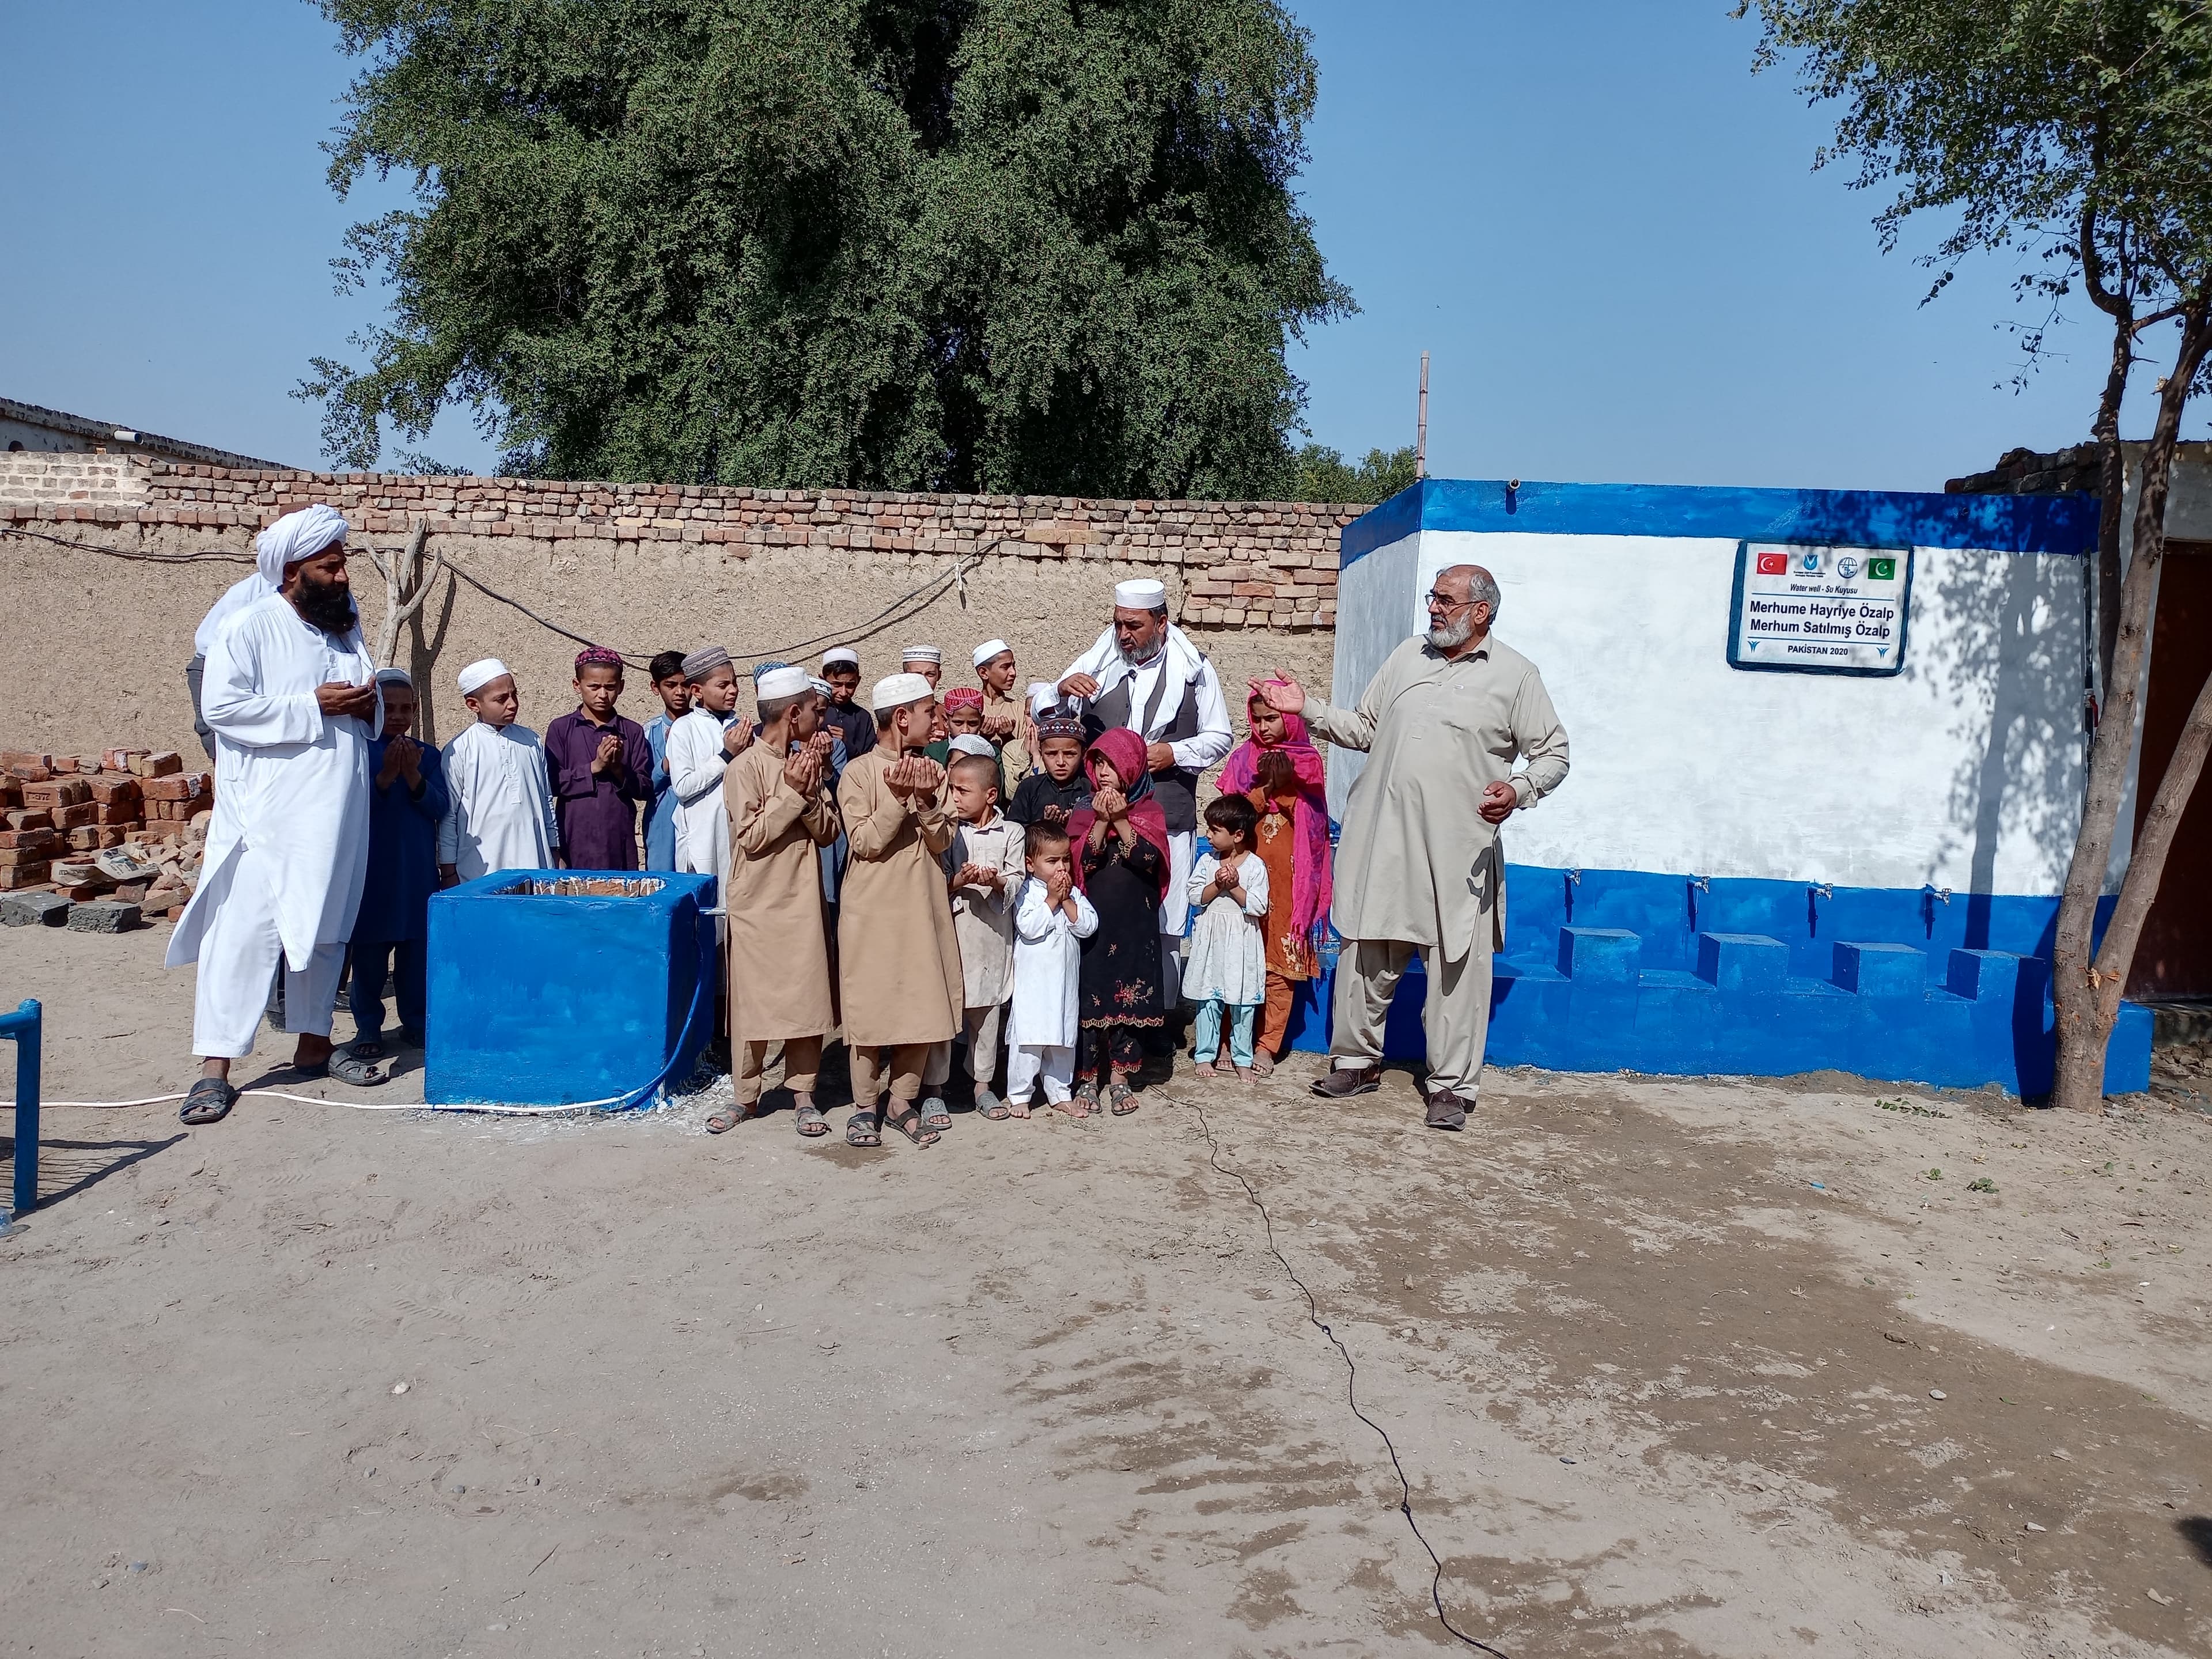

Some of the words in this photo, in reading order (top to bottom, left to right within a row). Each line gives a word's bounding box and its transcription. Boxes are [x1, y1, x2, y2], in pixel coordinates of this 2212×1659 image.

[1790, 584, 1808, 592] Water
[1835, 586, 1858, 595] Kuyusu
[1750, 600, 1806, 615] Merhume
[1810, 603, 1855, 619] Hayriye
[1860, 603, 1894, 622] Özalp
[1750, 619, 1799, 632] Merhum
[1804, 621, 1851, 638] Satılmış
[1855, 620, 1890, 639] Özalp
[1788, 644, 1828, 654] PAKİSTAN
